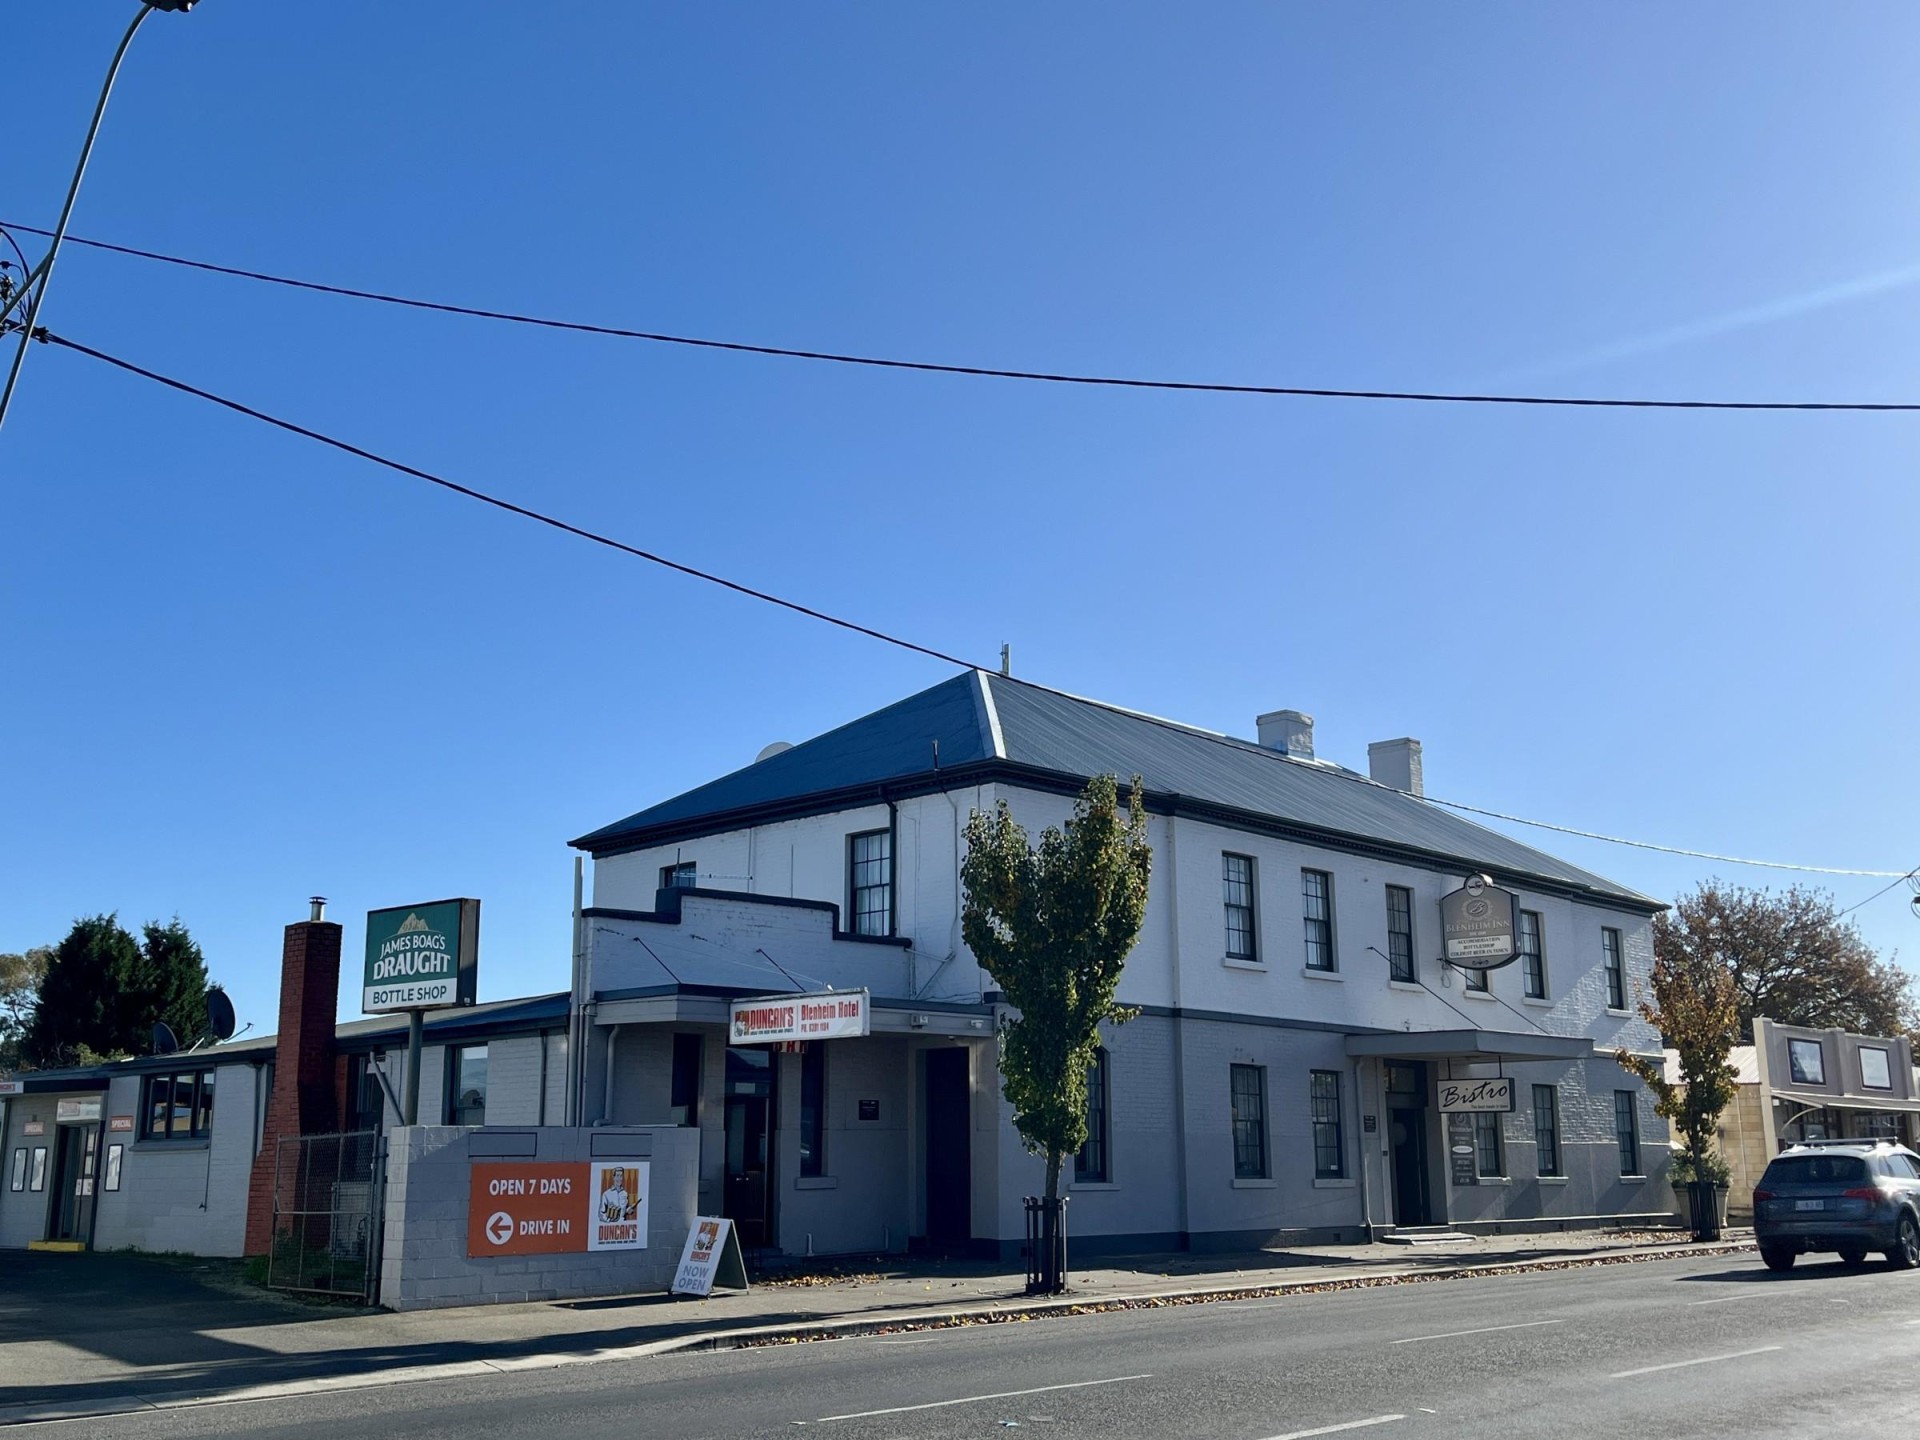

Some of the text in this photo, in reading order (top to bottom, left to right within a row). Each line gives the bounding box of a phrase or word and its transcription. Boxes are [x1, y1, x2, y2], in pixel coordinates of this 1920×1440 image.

[1446, 919, 1510, 932] BLENHEIM INN
[380, 934, 446, 959] JAMES BOAG'S
[373, 951, 451, 980] DRAUGHT
[373, 985, 447, 1004] BOTTLE SHOP
[750, 1006, 794, 1029] DUNCAN'S
[801, 1000, 859, 1021] Blenheim Hotel
[1440, 1081, 1508, 1107] Bistro
[111, 1119, 131, 1128] SPECIAL
[489, 1178, 571, 1196] OPEN 7 DAYS
[520, 1219, 570, 1236] DRIVE IN
[598, 1224, 637, 1240] DUNCAN'S
[683, 1265, 709, 1279] NOW
[678, 1278, 706, 1291] OPEN
